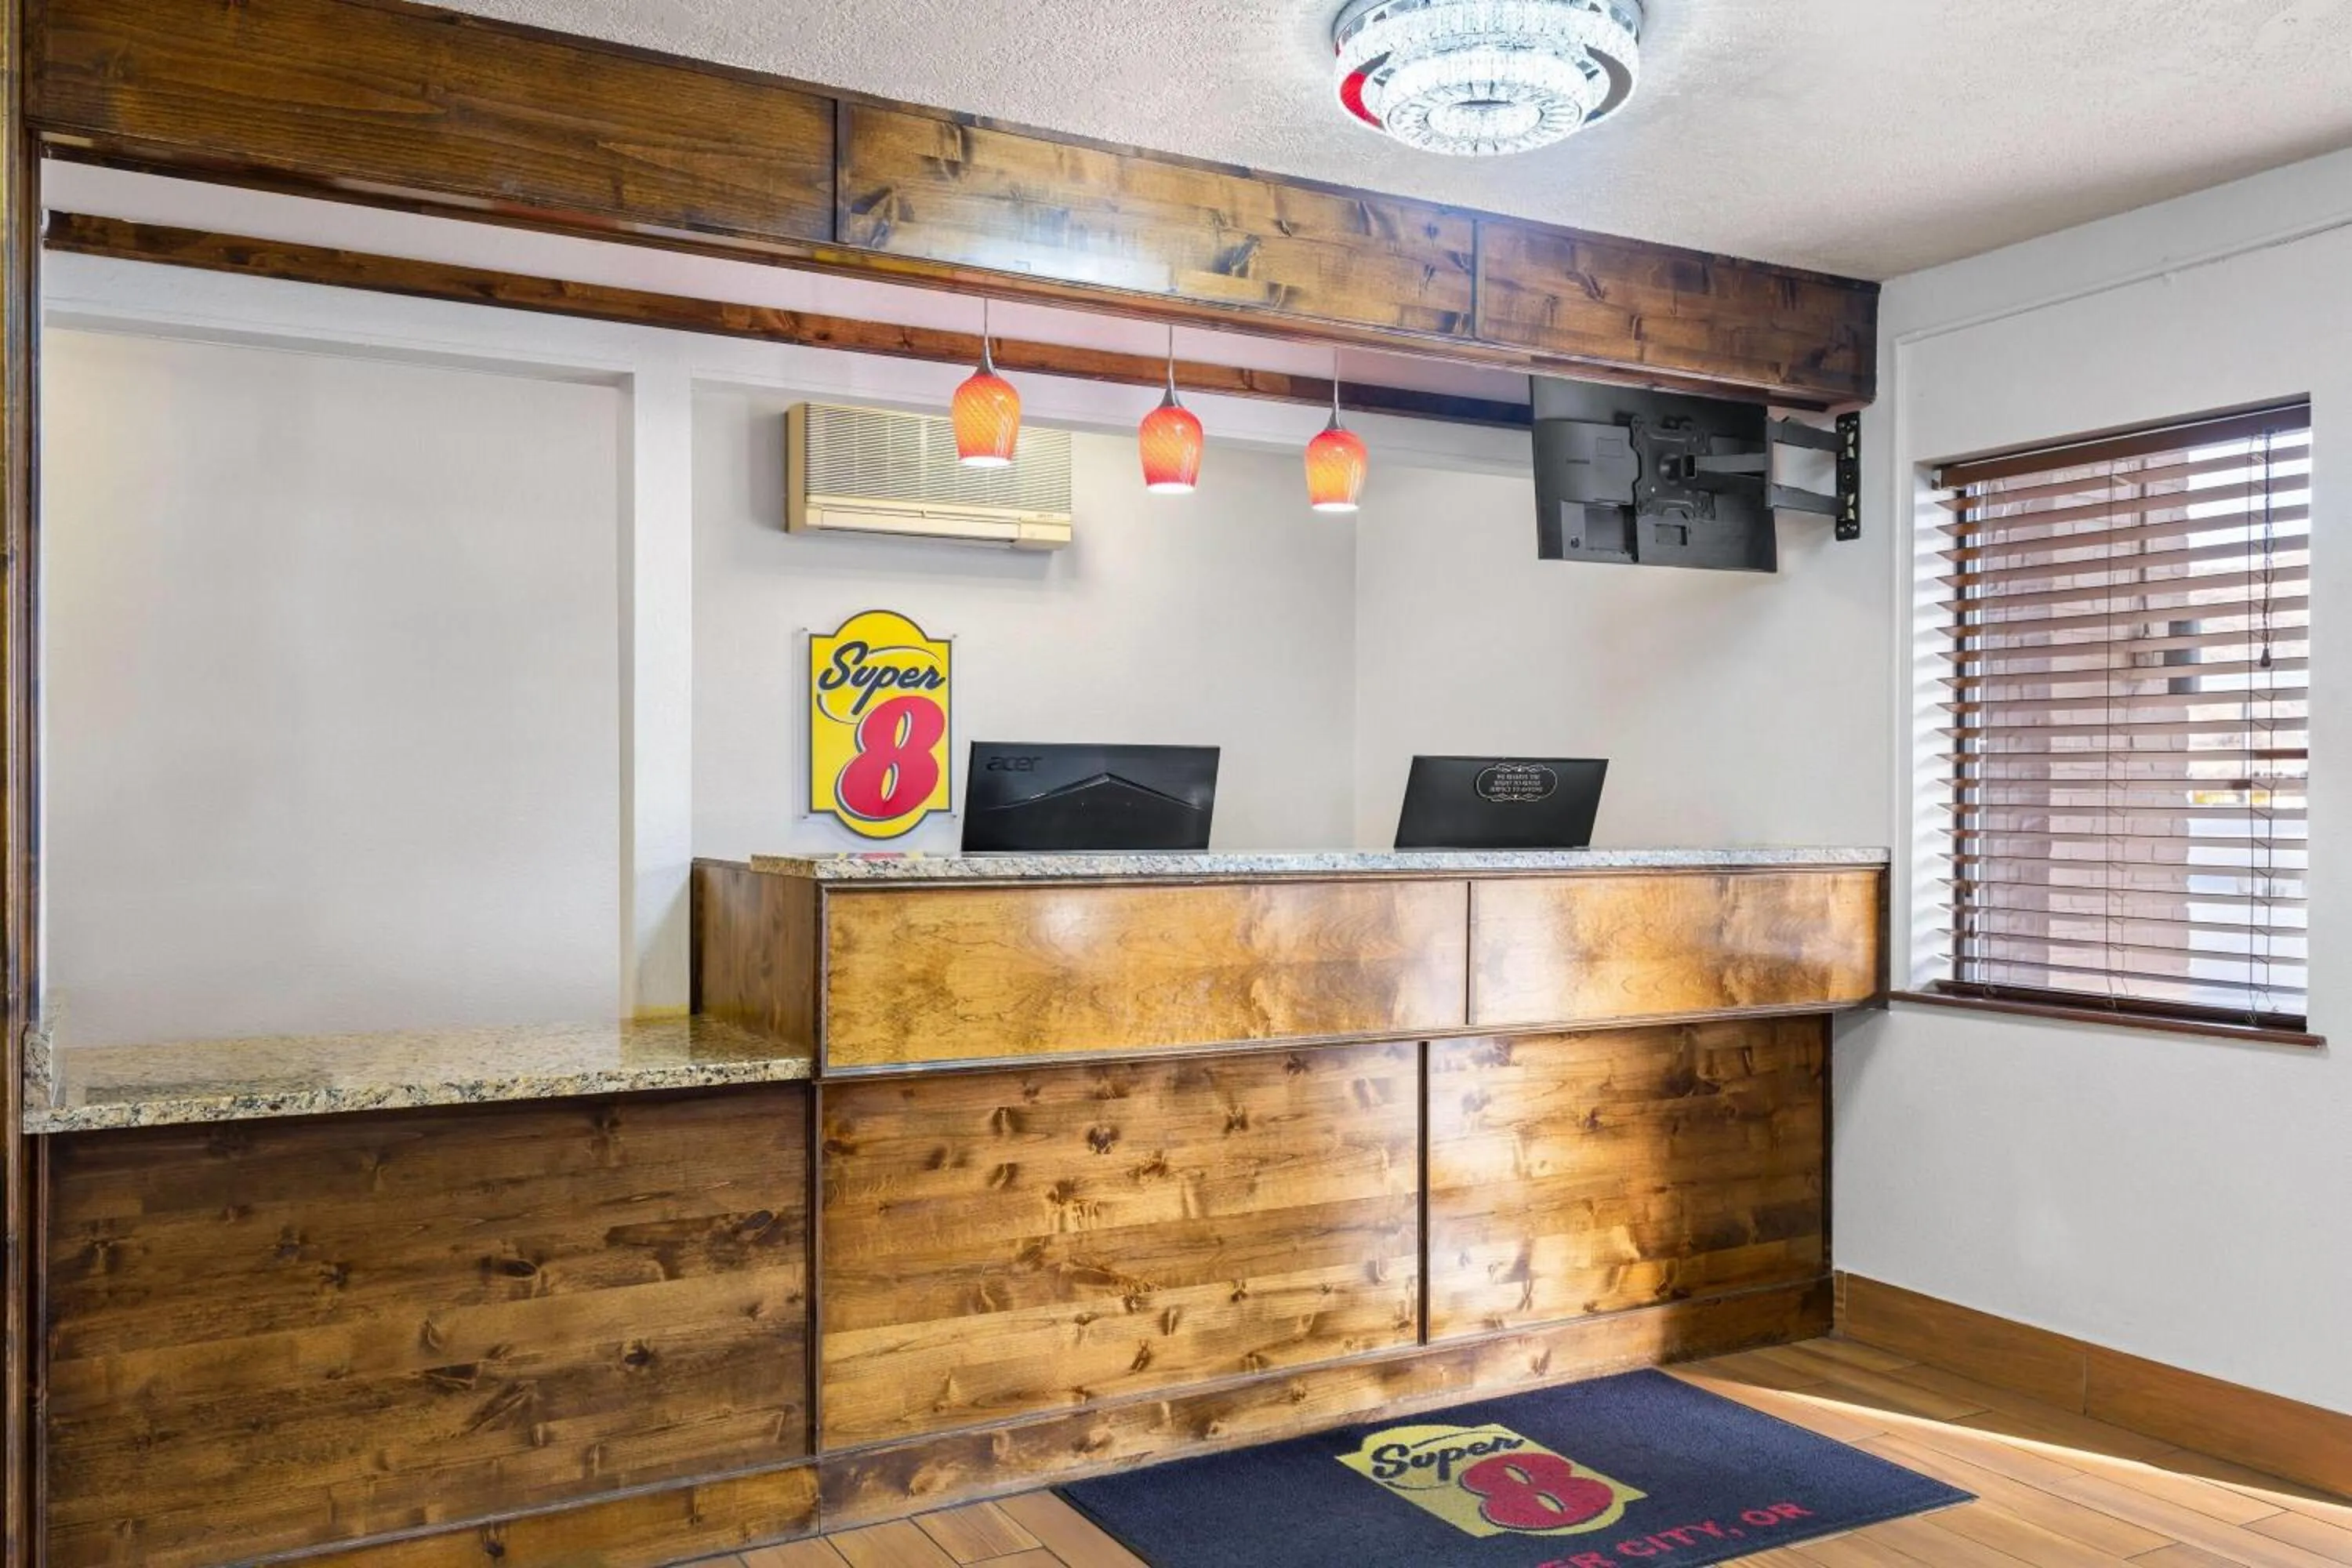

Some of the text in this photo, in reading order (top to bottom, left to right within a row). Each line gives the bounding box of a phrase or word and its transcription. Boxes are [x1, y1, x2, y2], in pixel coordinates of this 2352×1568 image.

[818, 641, 946, 716] Super
[834, 695, 946, 822] 8
[986, 755, 1043, 771] acer
[1370, 1436, 1525, 1482] Super
[1458, 1452, 1614, 1531] 8
[1617, 1520, 1746, 1557] CITY,
[1740, 1503, 1812, 1526] OR
